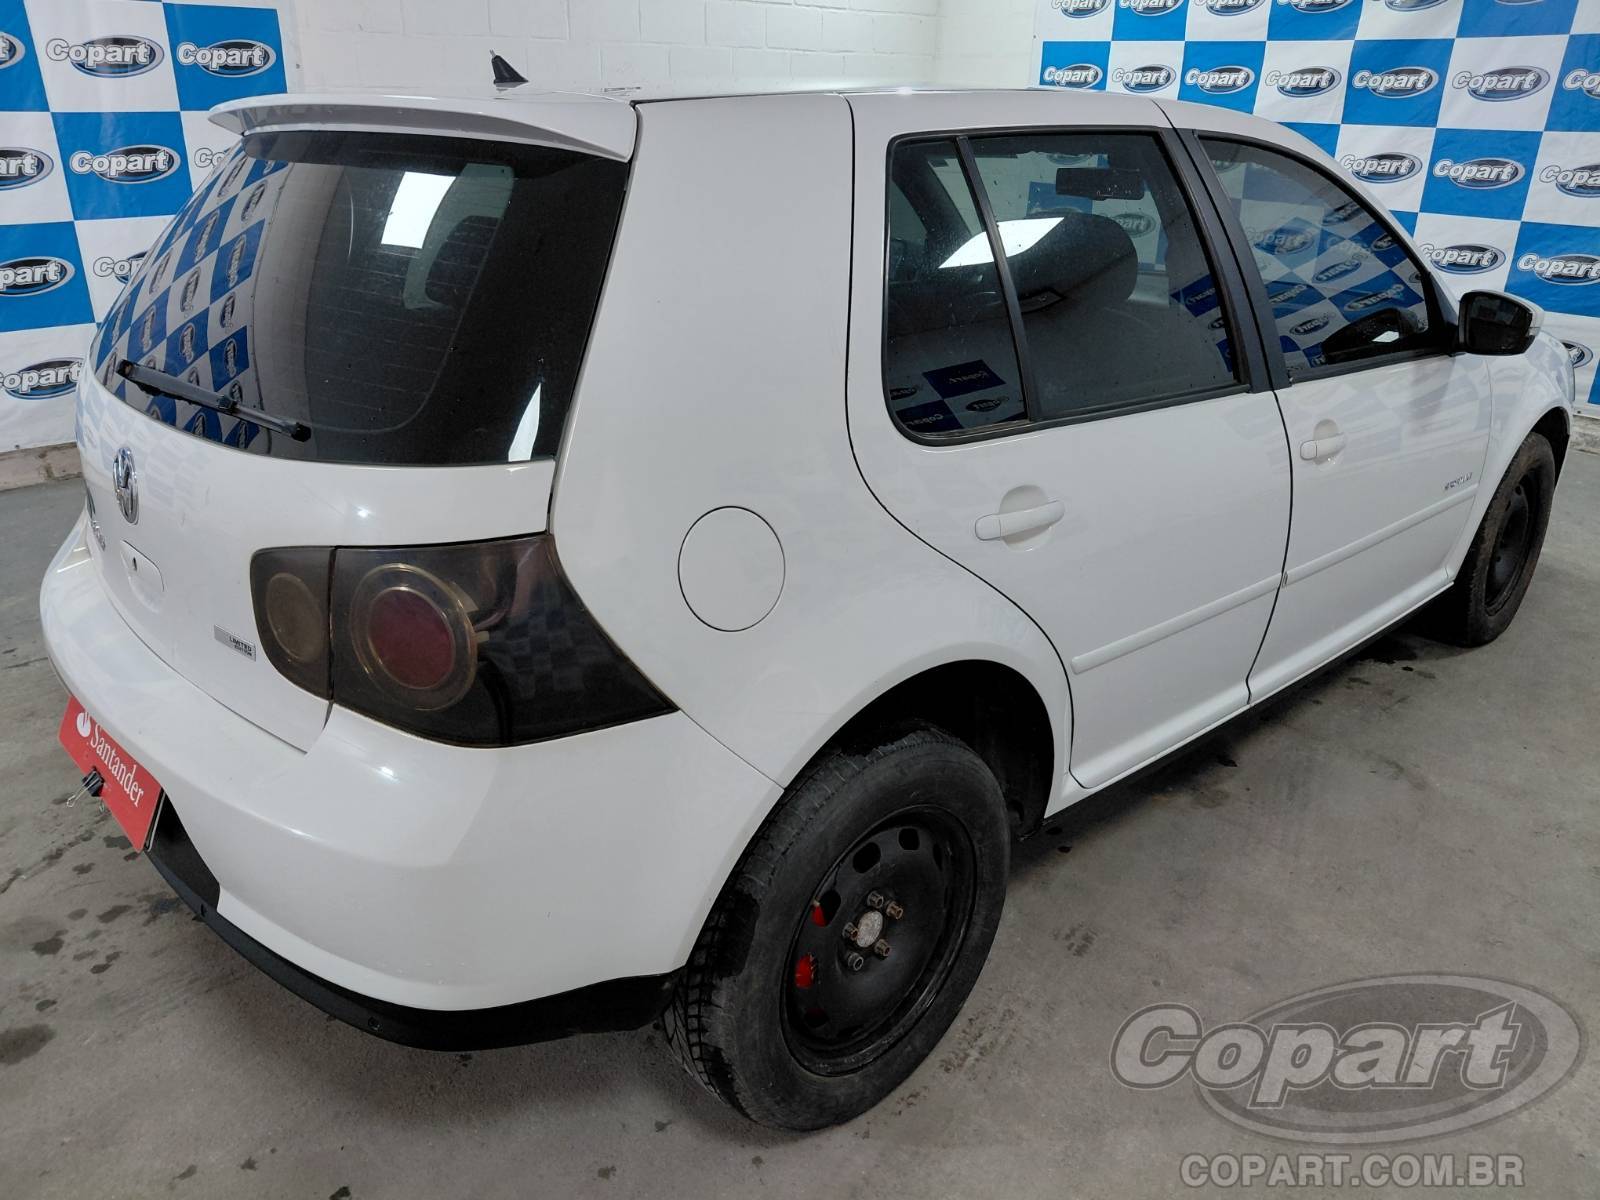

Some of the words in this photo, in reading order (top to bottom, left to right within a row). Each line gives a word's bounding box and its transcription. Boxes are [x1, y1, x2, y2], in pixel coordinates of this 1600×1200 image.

[46, 38, 150, 68] Copart
[177, 42, 264, 70] Copart
[1043, 66, 1097, 83] Copart
[1112, 67, 1168, 86] Copart
[1185, 68, 1246, 88] Copart
[1265, 70, 1331, 89] Copart
[1352, 69, 1433, 91] Copart
[1452, 70, 1540, 94] Copart
[70, 150, 168, 176] Copart
[1339, 154, 1416, 176] Copart
[1434, 159, 1518, 183] Copart
[0, 361, 81, 393] opart
[90, 723, 144, 808] Santander
